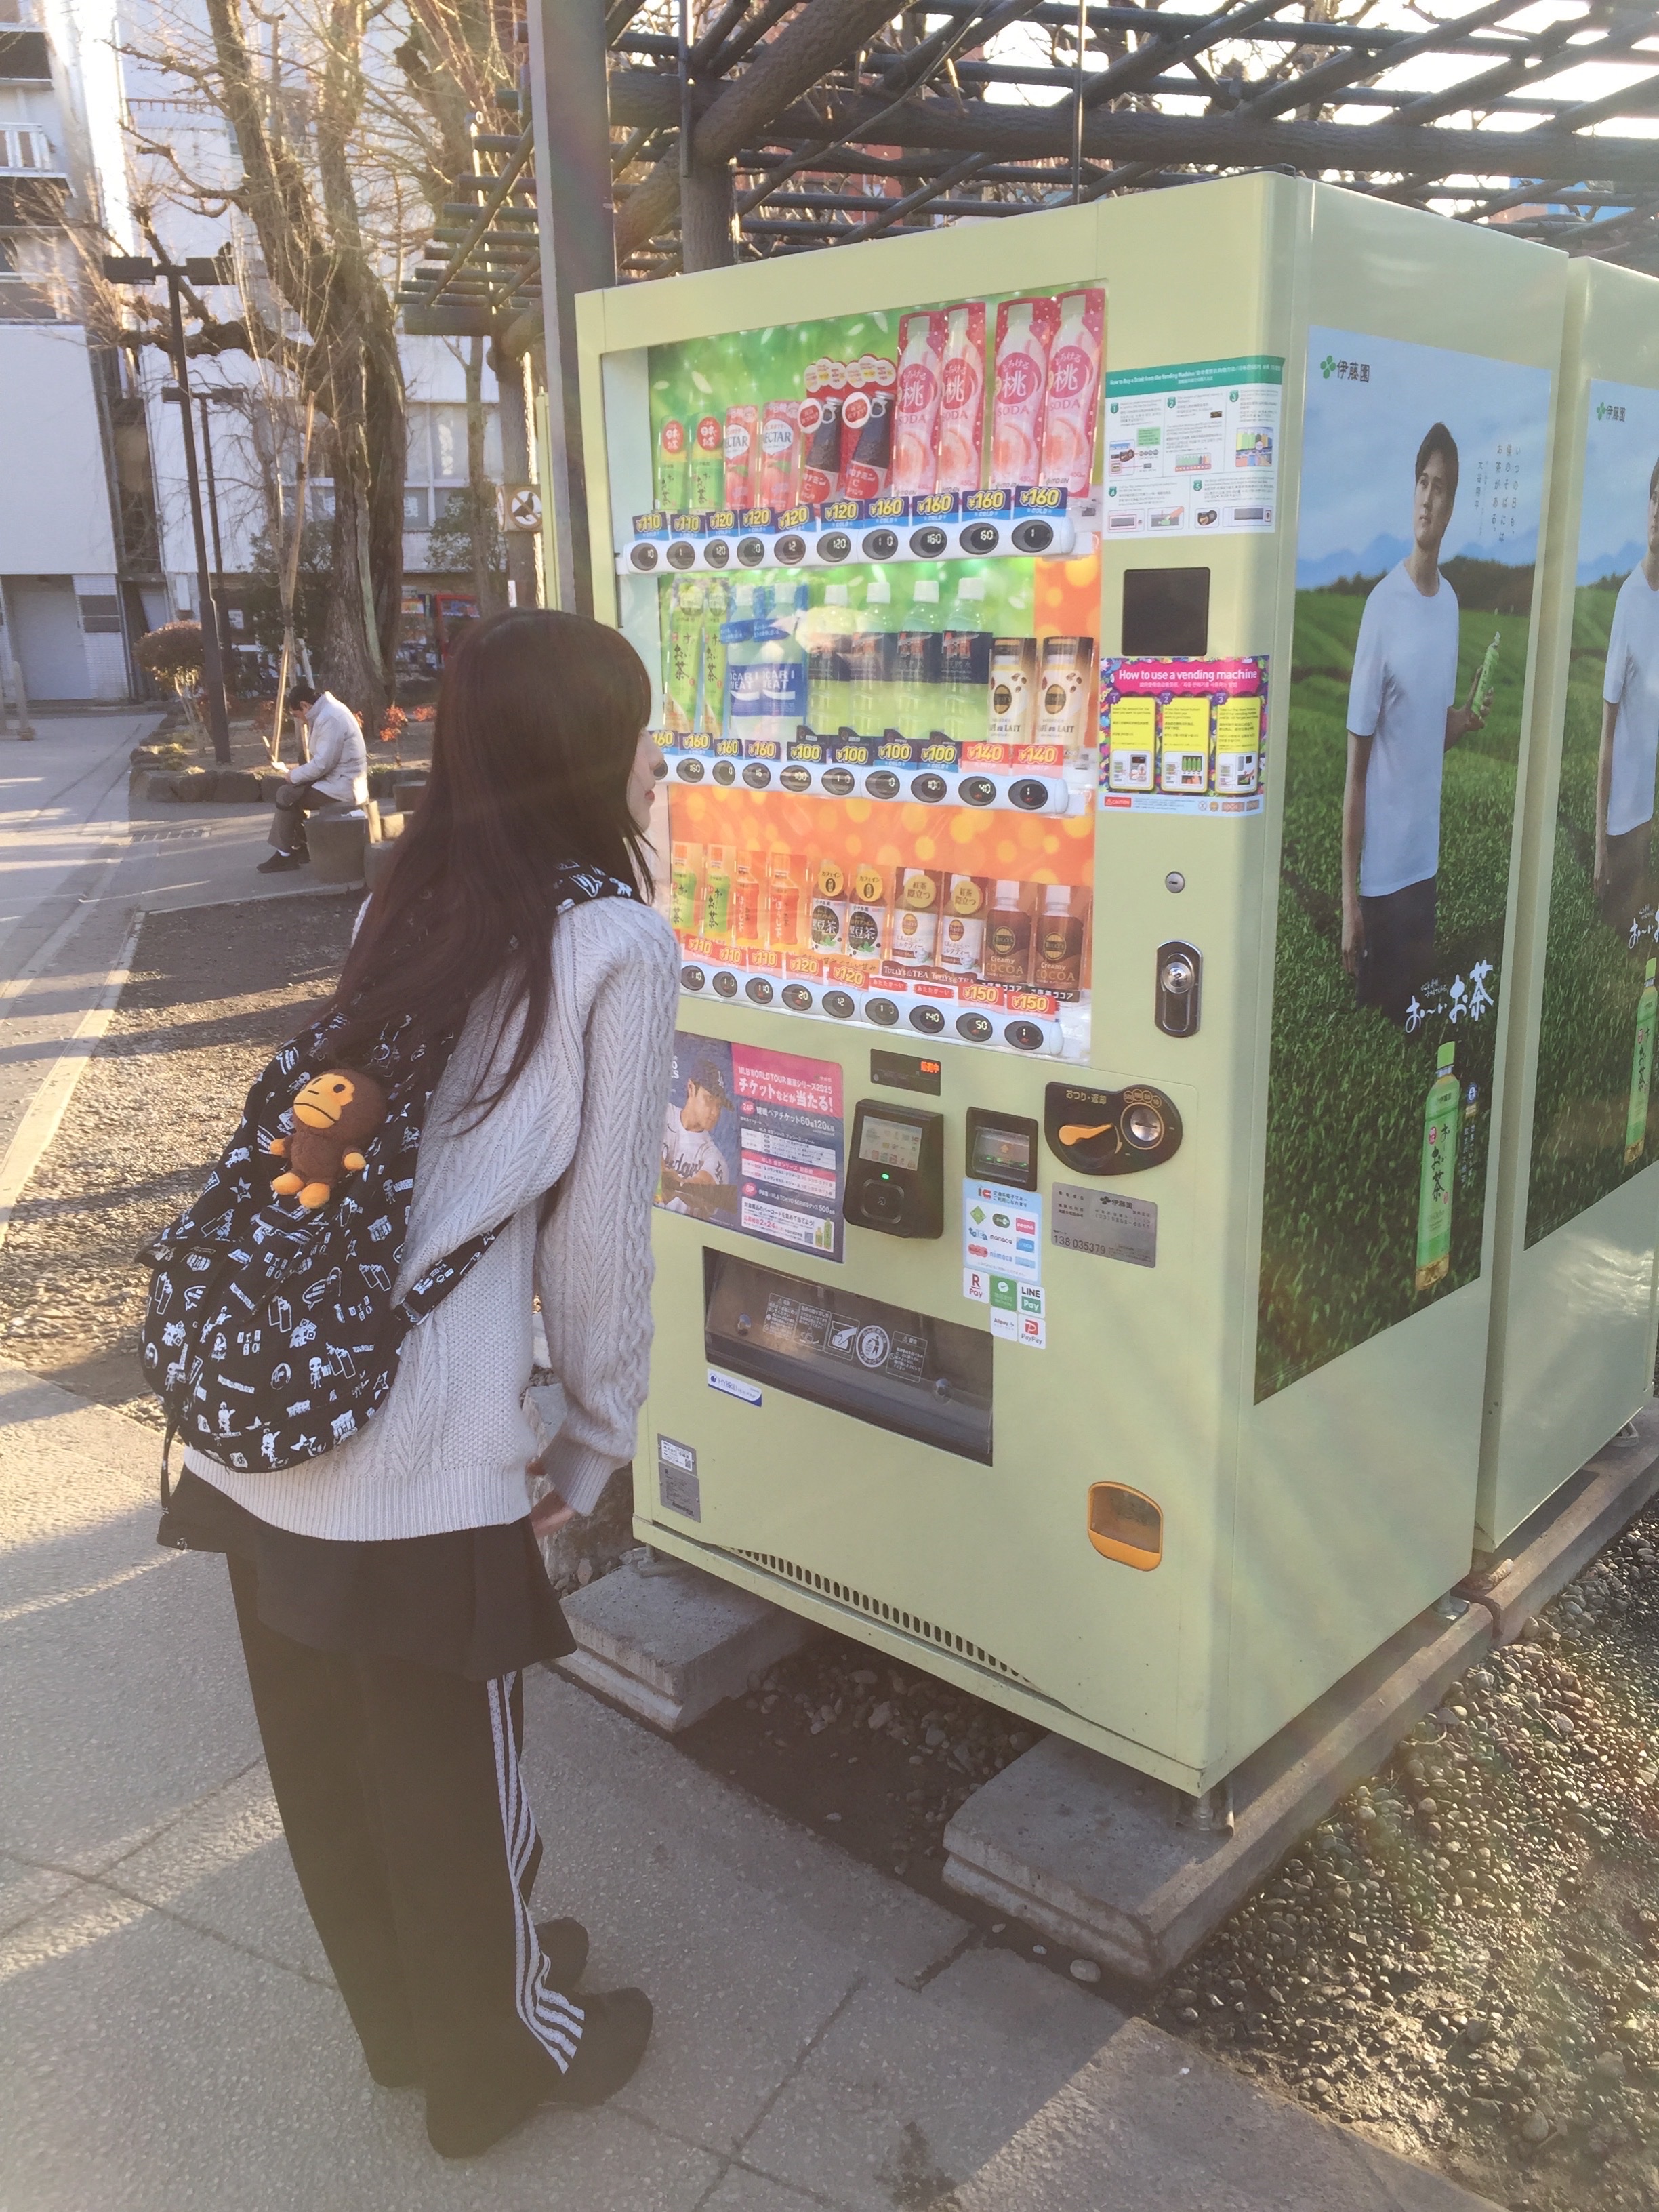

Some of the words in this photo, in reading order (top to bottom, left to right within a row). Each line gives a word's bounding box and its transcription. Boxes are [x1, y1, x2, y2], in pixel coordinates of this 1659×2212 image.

[1054, 363, 1078, 392] 桃
[1337, 360, 1370, 383] 伊藤園
[945, 375, 965, 403] 桃
[1003, 370, 1027, 398] 桃
[903, 380, 923, 407] 桃
[997, 405, 1029, 416] SODA
[1049, 398, 1080, 411] SODA
[898, 414, 927, 424] SODA
[943, 411, 968, 422] SODA
[1606, 405, 1626, 422] 伊藤園
[1492, 445, 1502, 531] お茶がある。
[918, 495, 951, 514] ¥160
[969, 491, 1003, 510] ¥160
[1022, 488, 1060, 506] ¥160
[826, 503, 857, 520] ¥120
[870, 499, 902, 516] ¥160
[637, 516, 661, 531] ¥110
[675, 517, 700, 531] ¥110
[711, 512, 734, 529] ¥120
[743, 510, 770, 525] ¥120
[780, 507, 808, 529] ¥120
[1119, 670, 1140, 680] How
[1141, 671, 1150, 679] to
[1177, 670, 1214, 682] vending
[1216, 670, 1257, 679] machine
[652, 733, 672, 746] 160
[683, 735, 709, 749] ¥160
[717, 741, 738, 756] ¥160
[749, 743, 776, 758] ¥160
[792, 744, 820, 760] ¥100
[836, 747, 867, 763] ¥100
[878, 744, 912, 759] ¥100
[922, 746, 956, 761] ¥100
[968, 744, 1003, 760] ¥140
[1019, 747, 1057, 762] ¥140
[825, 878, 836, 893] 0
[864, 883, 874, 899] 0
[912, 882, 927, 890] 紅茶
[960, 887, 972, 897] 紅茶
[907, 890, 930, 899] 際立つ
[955, 897, 976, 905] 際立つ
[689, 939, 712, 954] ¥110
[720, 948, 741, 962] ¥110
[752, 951, 777, 965] ¥110
[991, 956, 1015, 964] Creamy
[792, 958, 819, 974] ¥120
[987, 962, 1024, 975] COCOA
[1041, 962, 1066, 970] Creamy
[834, 967, 864, 985] ¥120
[964, 986, 998, 1002] ¥150
[1012, 994, 1047, 1010] ¥150
[990, 1235, 1012, 1244] manaca
[1054, 1235, 1070, 1246] 138
[1072, 1239, 1106, 1254] 035379
[972, 1273, 980, 1287] R
[969, 1288, 983, 1298] Pay
[1021, 1287, 1040, 1298] LINE
[1023, 1298, 1039, 1311] Pay
[1021, 1332, 1042, 1345] PayPay
